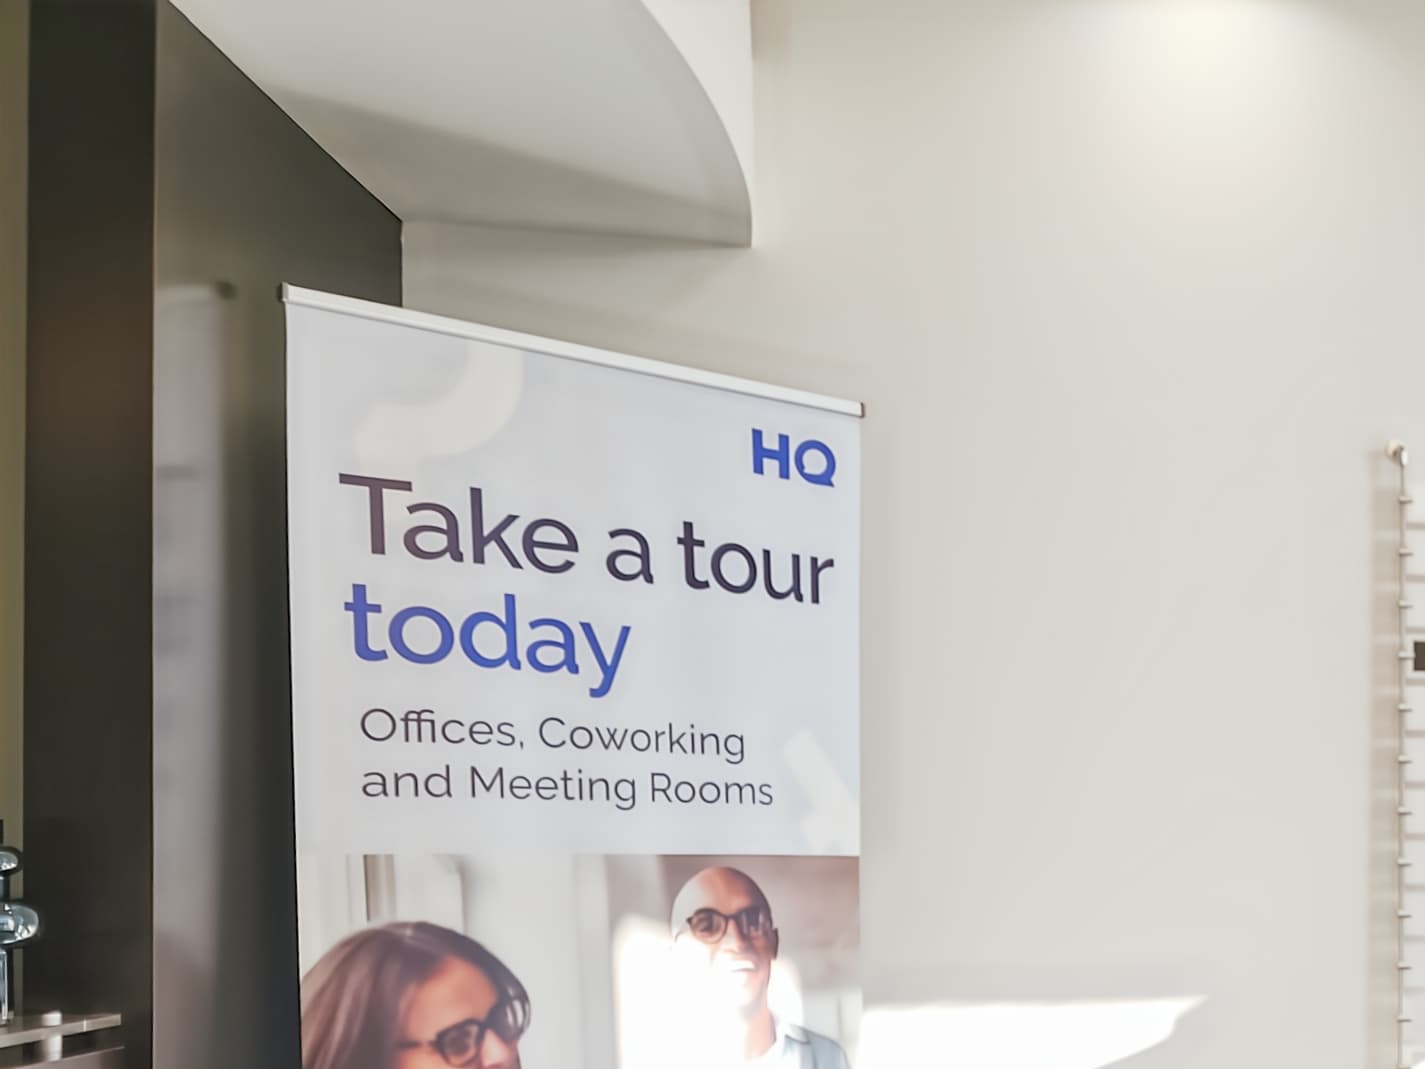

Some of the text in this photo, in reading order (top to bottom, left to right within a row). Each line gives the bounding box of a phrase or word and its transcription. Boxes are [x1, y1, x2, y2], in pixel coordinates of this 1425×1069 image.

[751, 428, 836, 488] HQ
[339, 472, 835, 604] Take a tour
[344, 583, 632, 698] today
[360, 708, 745, 764] Offices, Coworking
[361, 764, 774, 811] and Meeting Rooms
